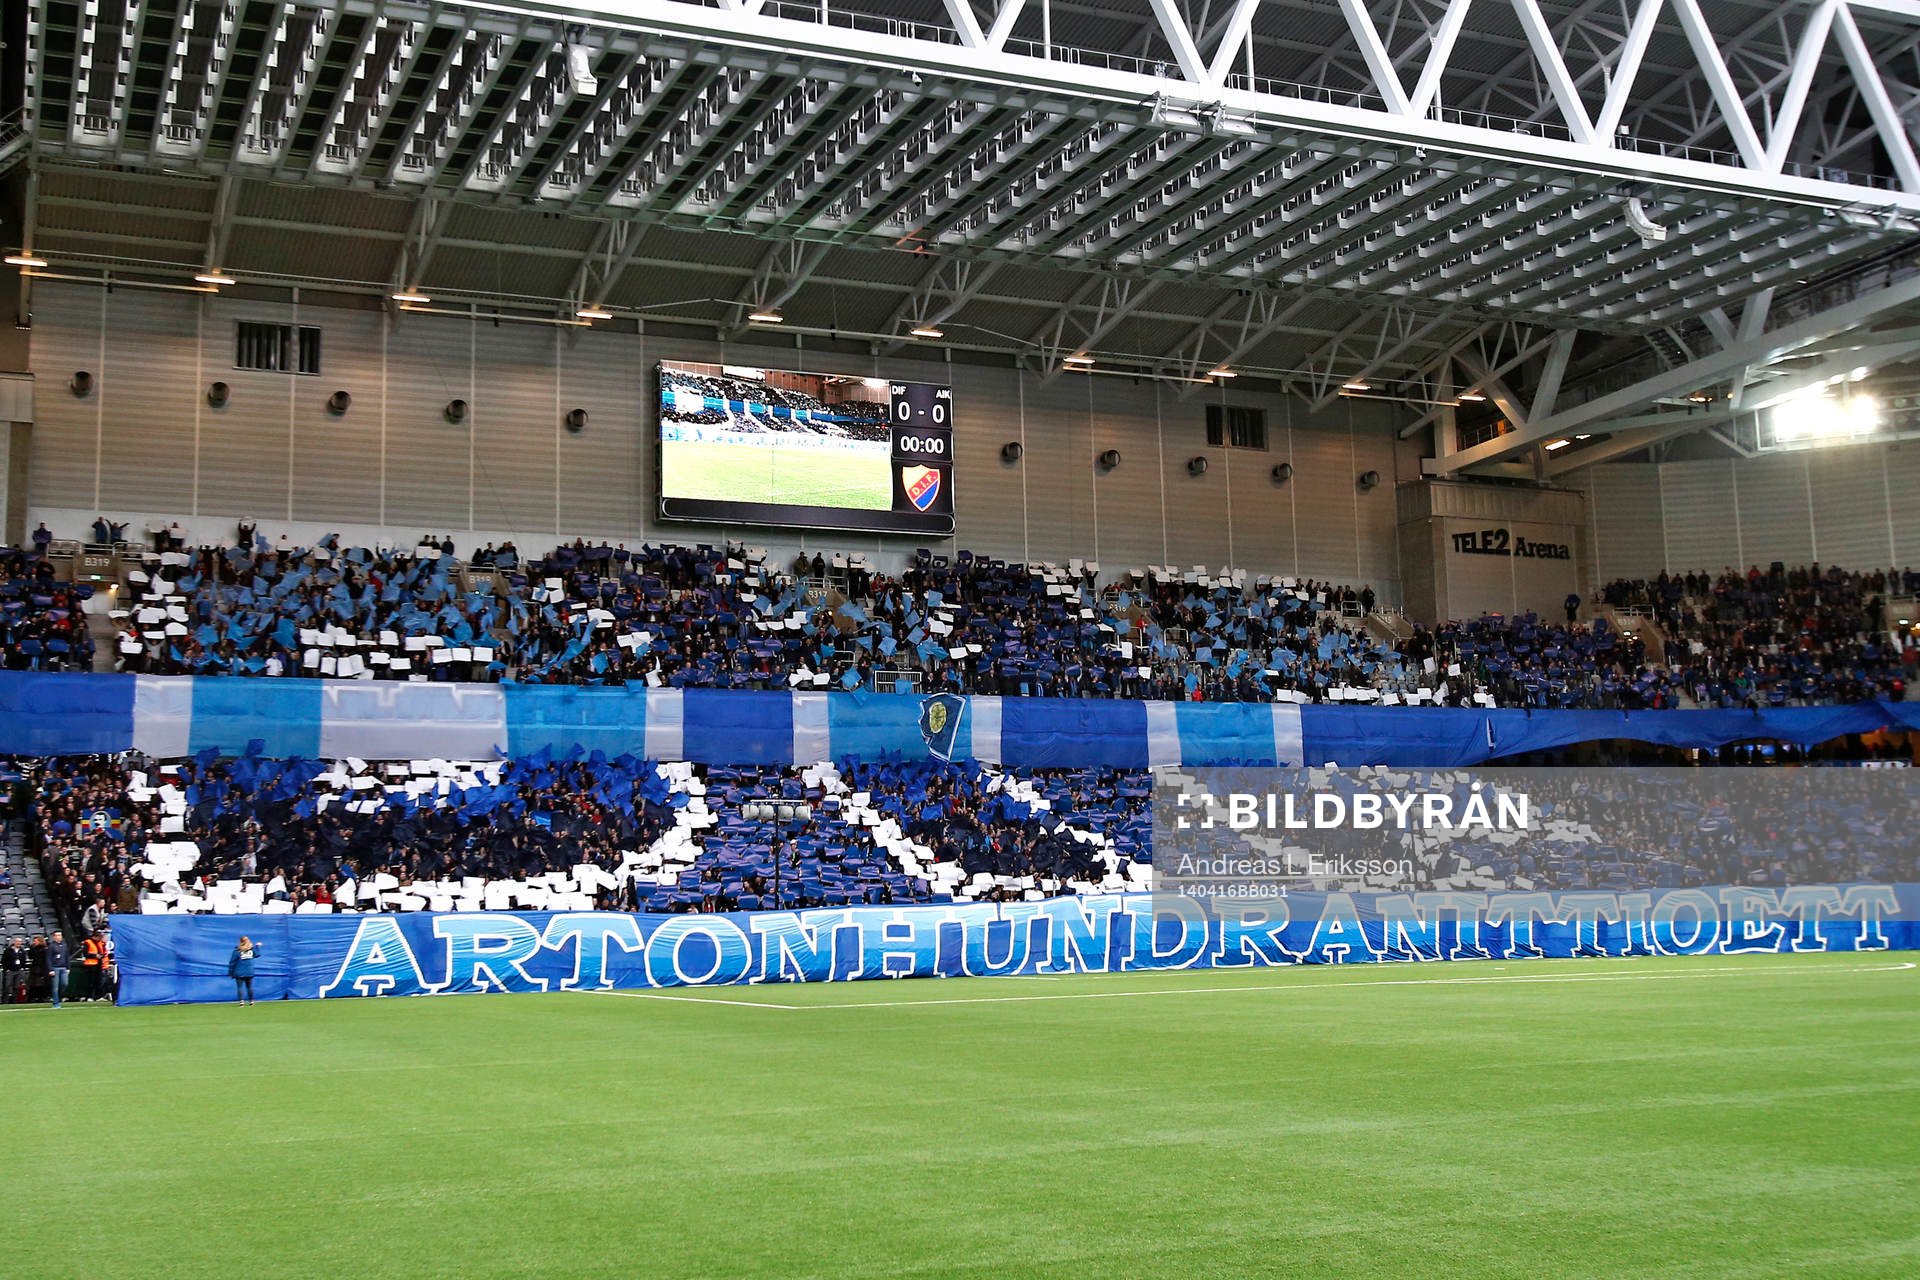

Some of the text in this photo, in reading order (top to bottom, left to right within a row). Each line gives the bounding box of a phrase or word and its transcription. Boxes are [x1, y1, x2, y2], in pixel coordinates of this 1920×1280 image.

[891, 385, 951, 399] DIF AIK
[898, 401, 910, 421] 0
[932, 404, 944, 424] 0
[900, 435, 944, 454] 00:00
[1452, 528, 1570, 560] TELE2 Arena
[84, 557, 110, 567] B319
[319, 885, 1901, 998] ARTONHUNDRANITTIOETT
